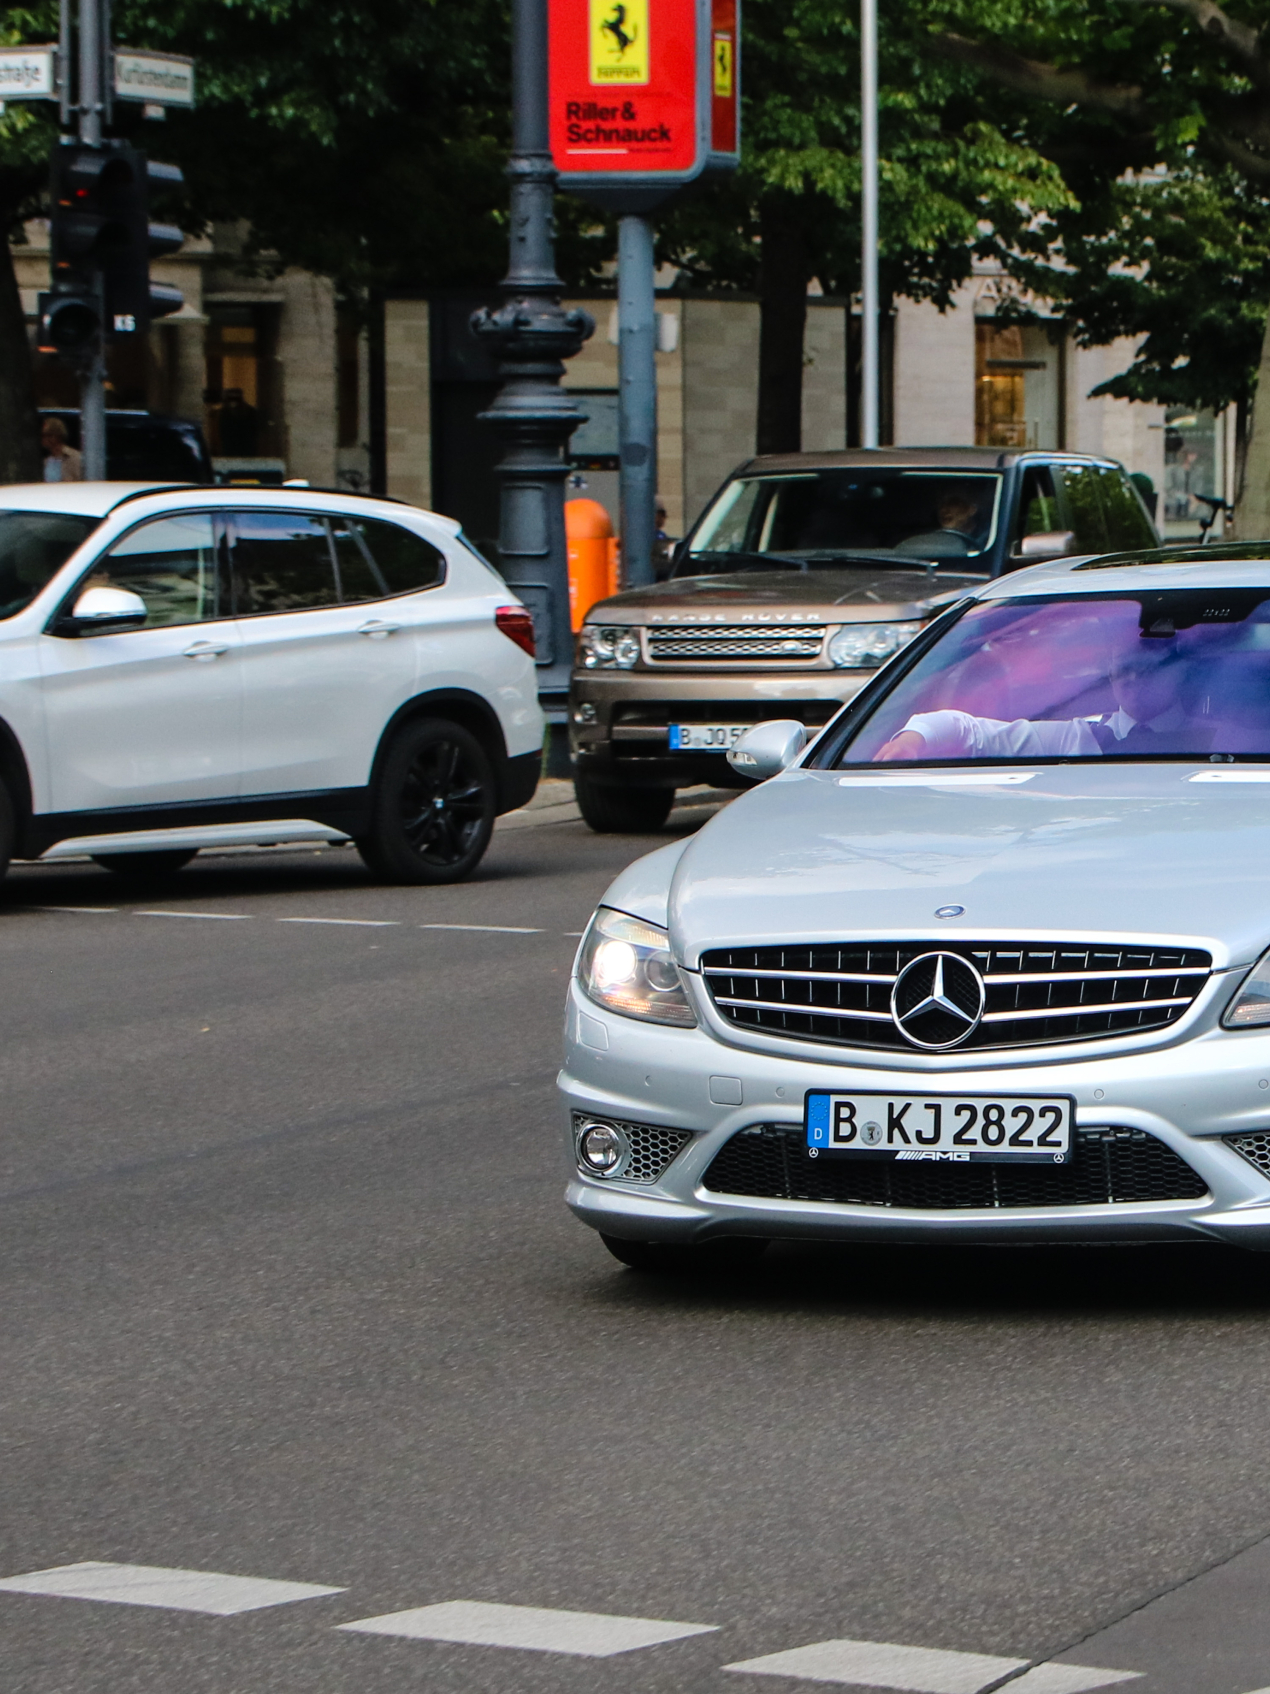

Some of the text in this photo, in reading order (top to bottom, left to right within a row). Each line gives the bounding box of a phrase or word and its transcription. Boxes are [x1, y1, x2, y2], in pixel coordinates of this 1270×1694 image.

[566, 102, 635, 120] Riller &
[567, 123, 671, 142] Schnauck
[652, 613, 820, 621] RANGE ROVER
[681, 728, 690, 745] B
[814, 1101, 1063, 1147] D B KJ 2822
